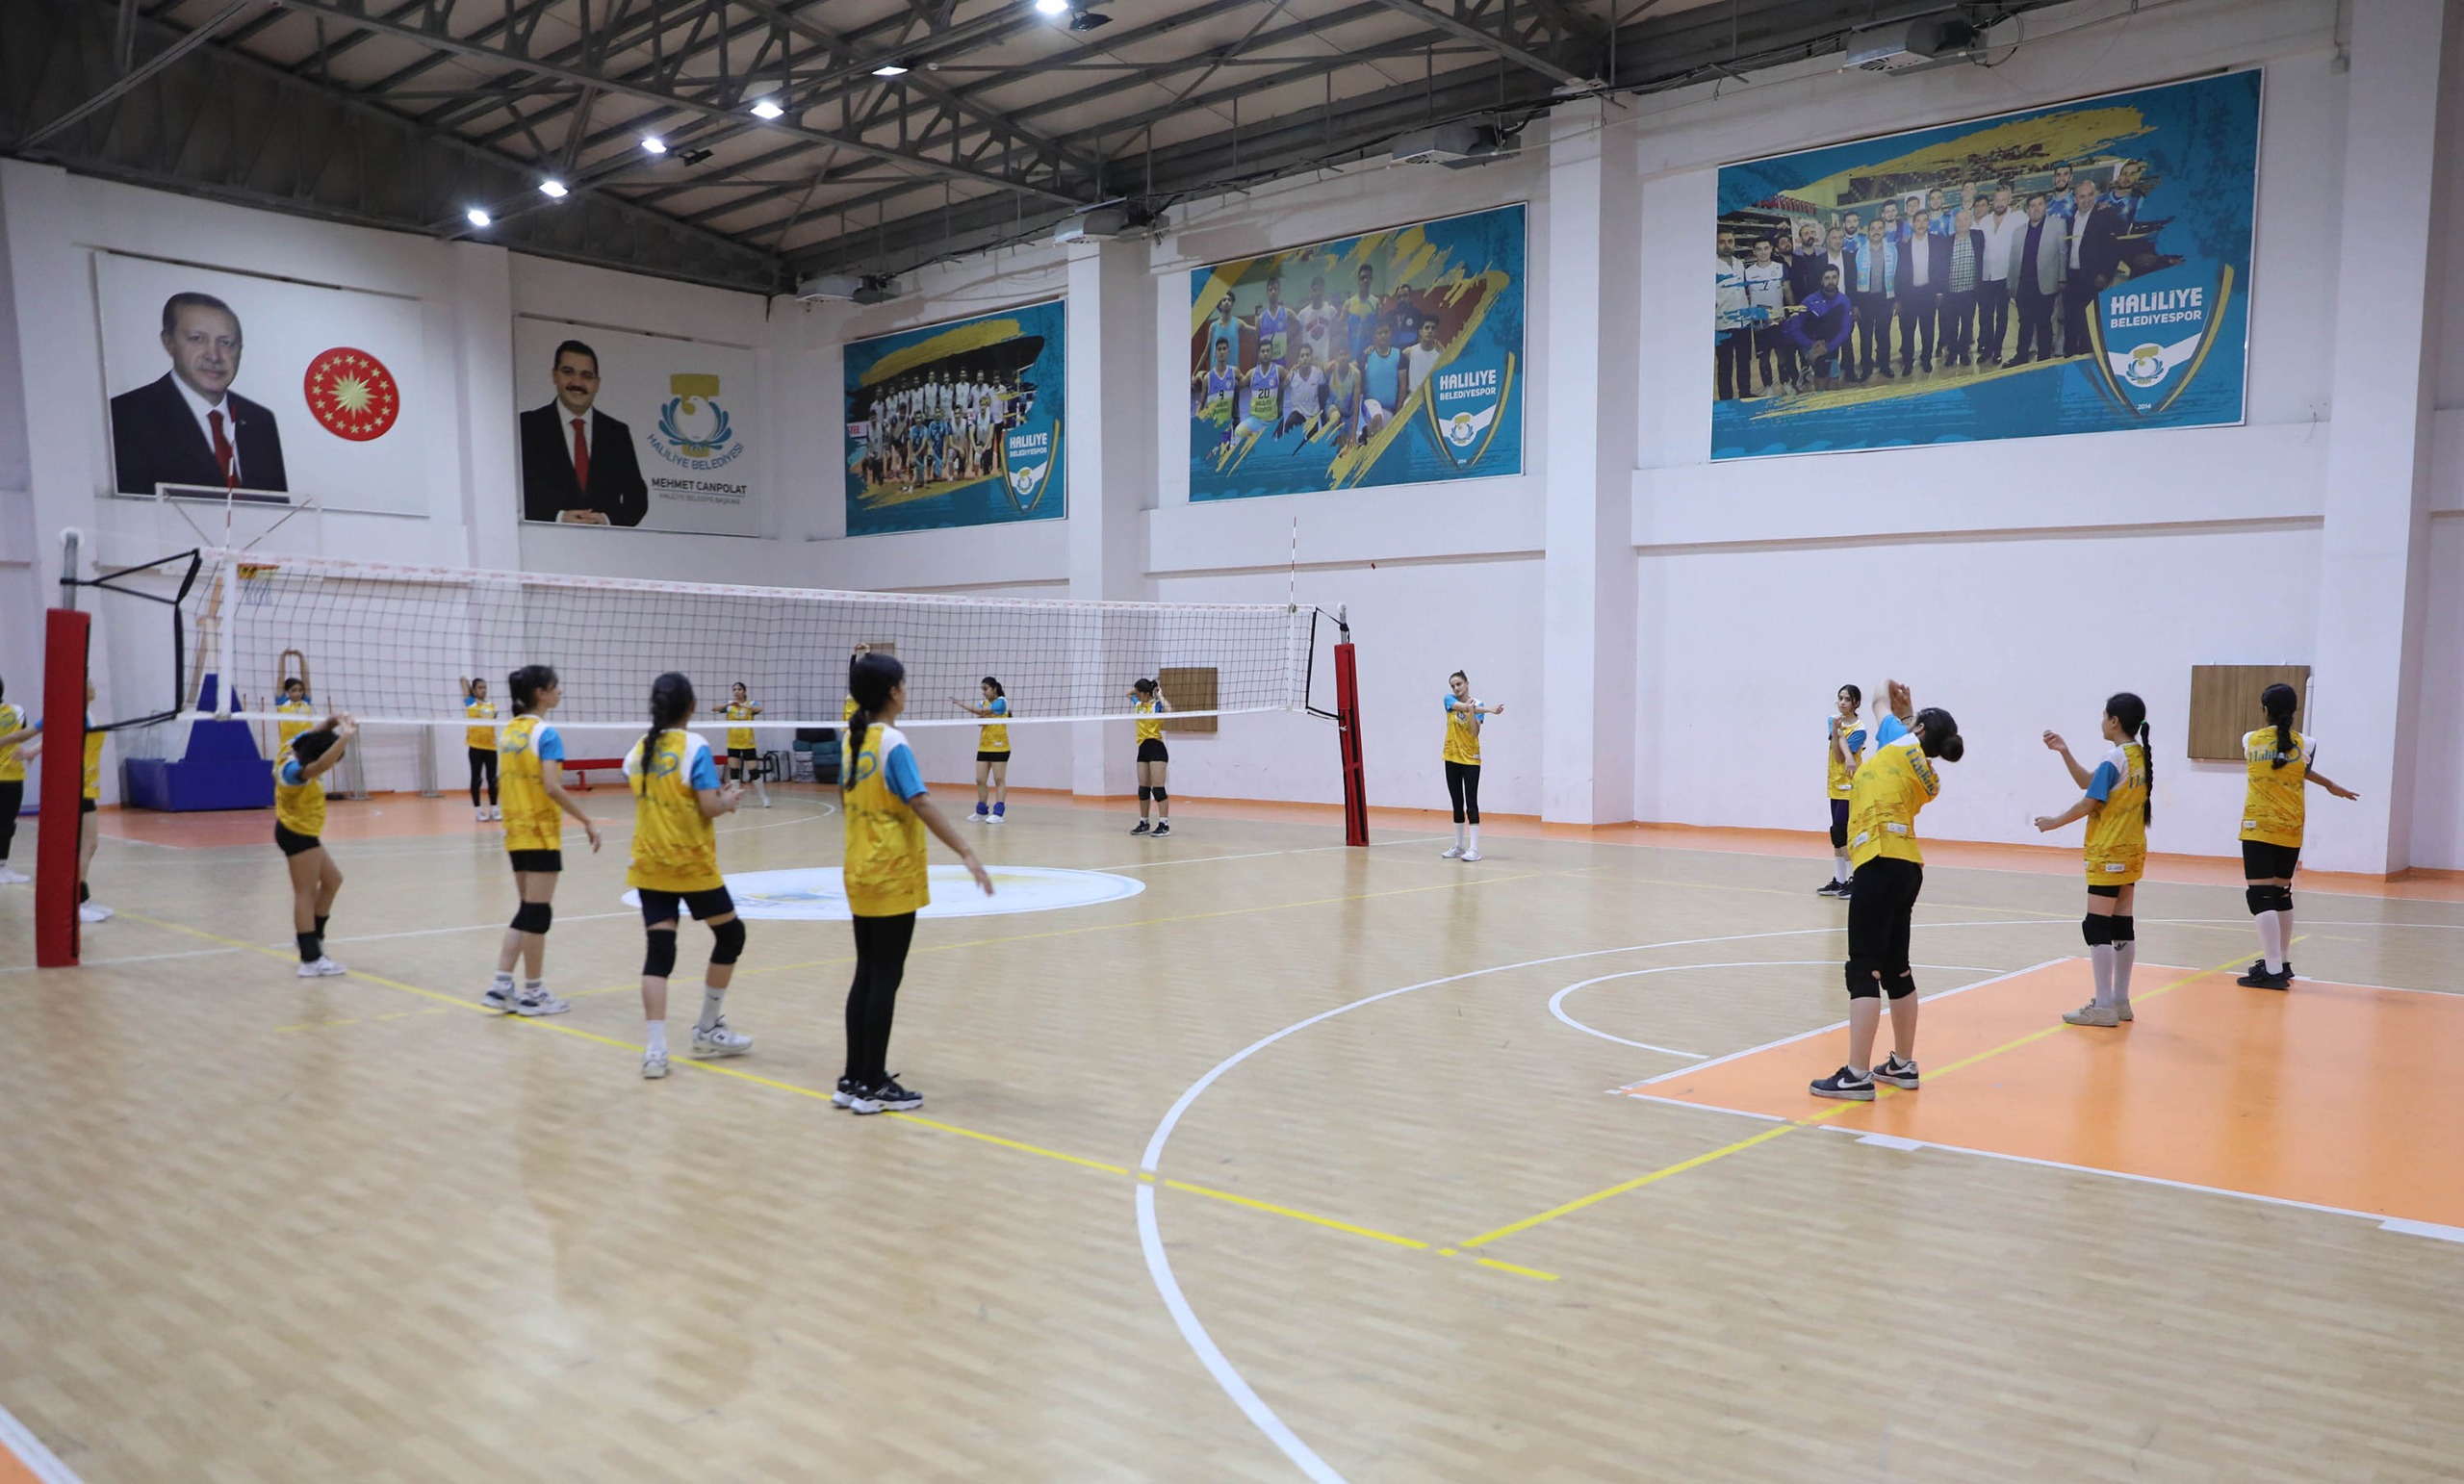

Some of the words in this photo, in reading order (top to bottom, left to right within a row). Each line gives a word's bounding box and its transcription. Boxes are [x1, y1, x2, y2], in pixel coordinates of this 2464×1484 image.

[1219, 390, 1224, 400] 9
[1258, 388, 1270, 399] 20
[652, 477, 695, 490] MEHMET
[696, 481, 747, 495] CANPOLAT
